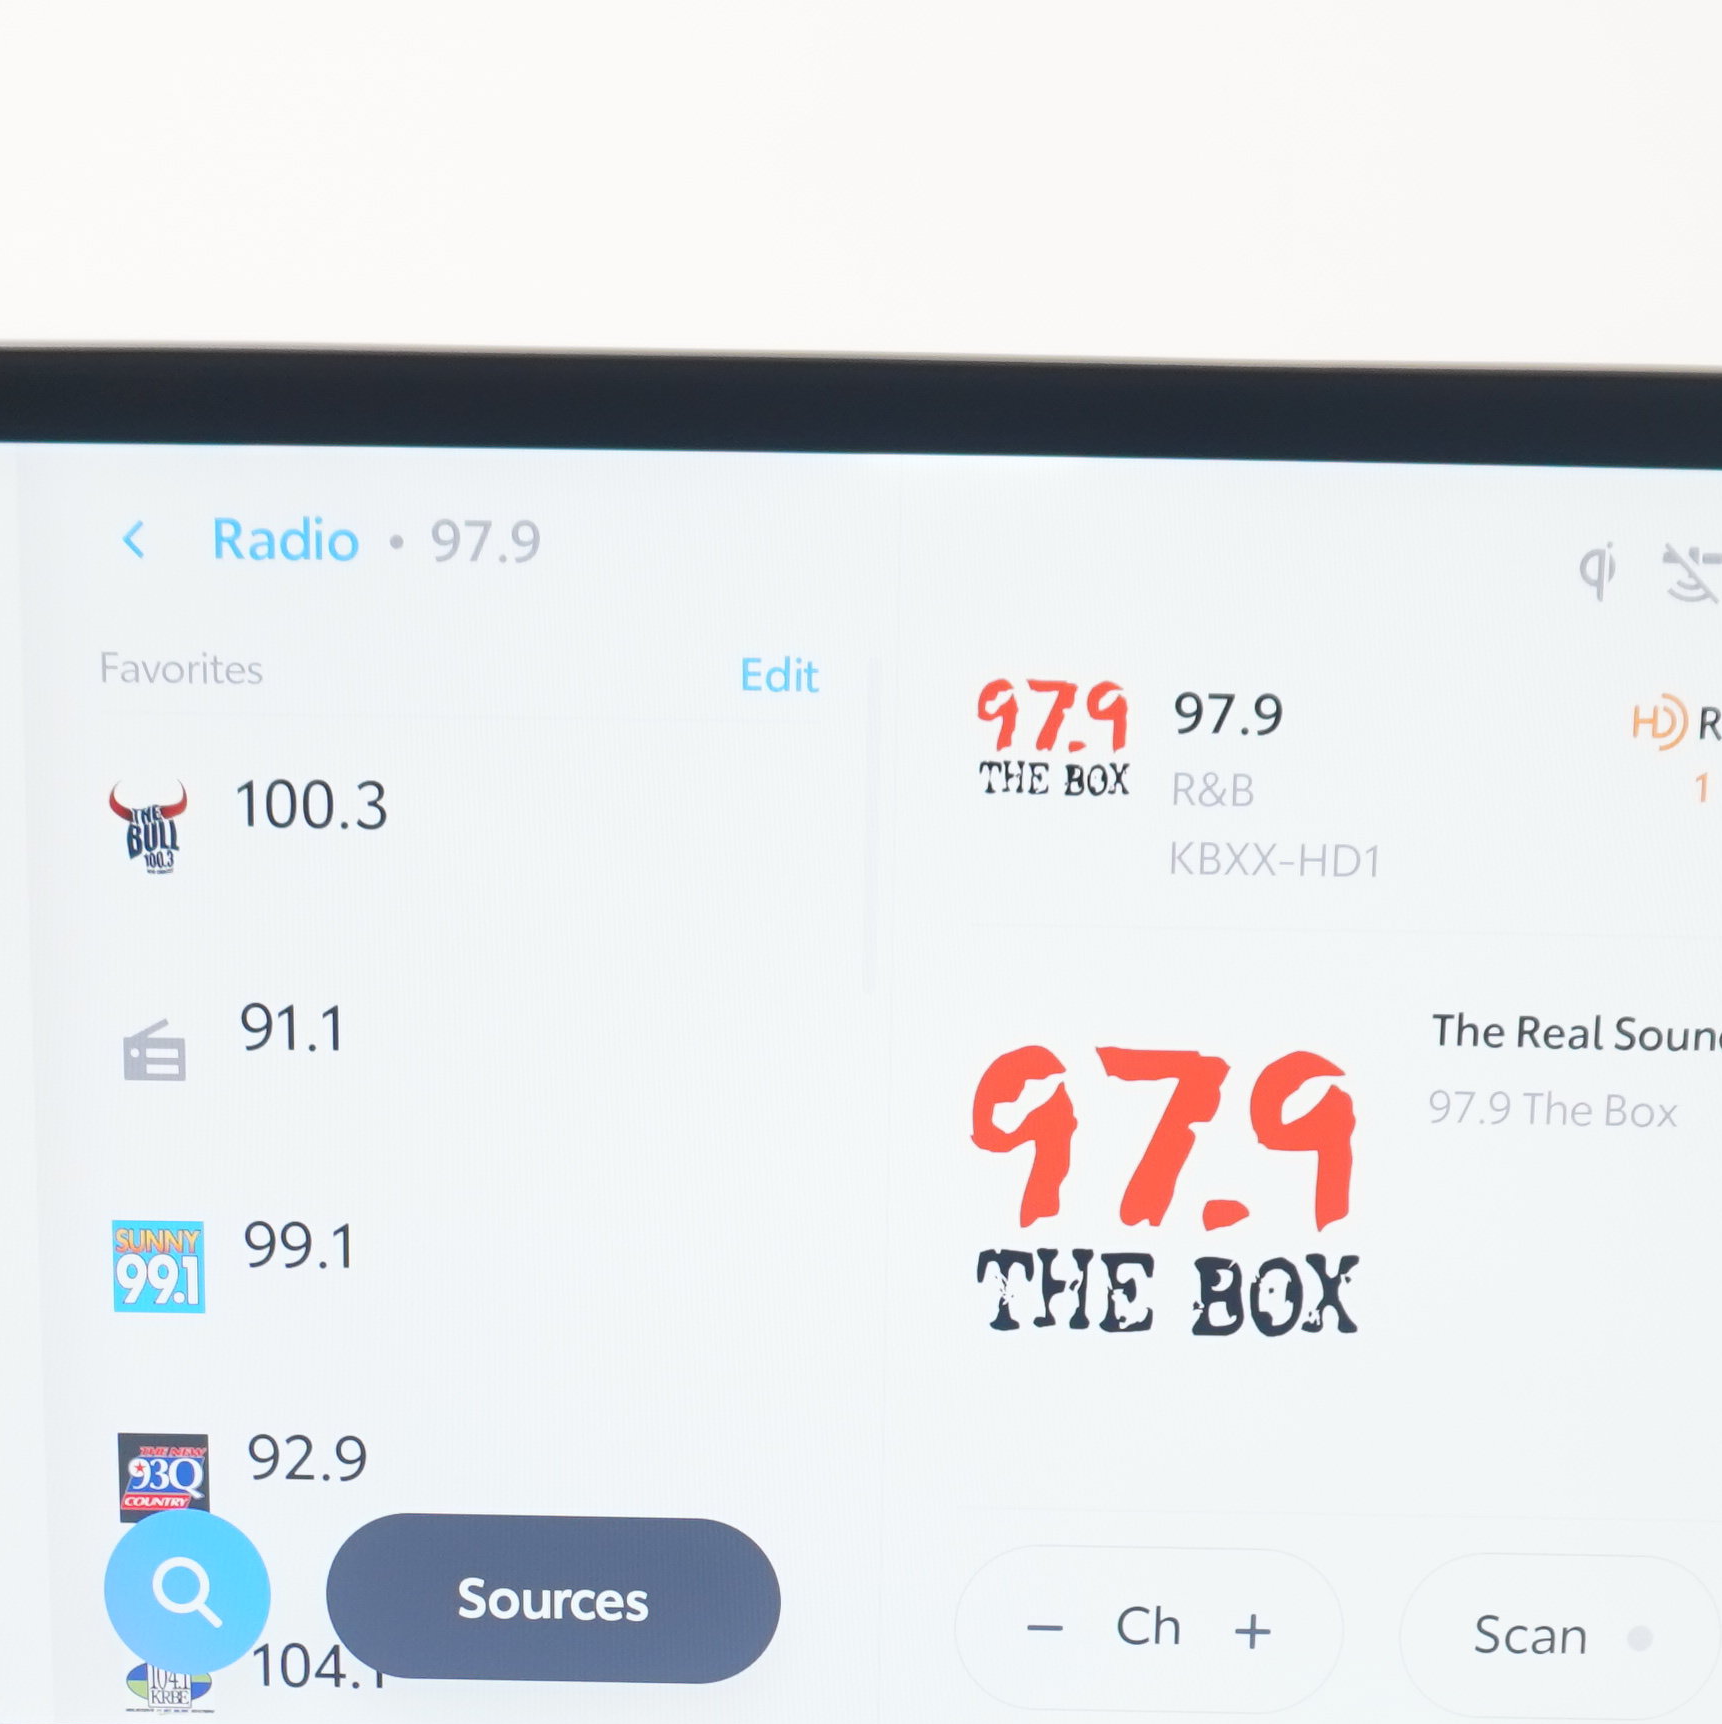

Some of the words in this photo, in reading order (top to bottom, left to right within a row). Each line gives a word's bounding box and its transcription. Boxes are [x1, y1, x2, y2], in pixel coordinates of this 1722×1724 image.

[213, 517, 360, 562] Radio
[430, 518, 542, 565] 97.9
[99, 651, 263, 687] Favorites
[741, 656, 819, 693] Edit
[976, 679, 1129, 751] 97.9
[1173, 692, 1284, 738] 97.9
[978, 760, 1050, 794] THE
[1064, 763, 1130, 797] BOX
[1171, 772, 1254, 807] R&B
[1695, 773, 1708, 802] 1
[237, 779, 388, 831] 100.3
[127, 819, 179, 860] BULL
[144, 850, 174, 868] 100.3
[1169, 840, 1381, 878] KBXX-HD1
[240, 1003, 343, 1052] 91.1
[1433, 1013, 1505, 1048] The
[1516, 1014, 1603, 1051] Real
[1428, 1090, 1511, 1127] 97.9
[1523, 1091, 1592, 1127] The
[1603, 1093, 1677, 1128] Box
[970, 1045, 1355, 1231] 97.9
[115, 1228, 199, 1255] SUNNY
[244, 1221, 353, 1269] 99.1
[116, 1254, 199, 1307] 99.1
[977, 1248, 1154, 1333] THE
[1193, 1255, 1358, 1336] BOX
[248, 1434, 367, 1481] 92.9
[128, 1458, 205, 1499] 93Q
[124, 1496, 189, 1507] COUNTRY
[458, 1577, 649, 1623] Sources
[1117, 1605, 1181, 1645] Ch
[1474, 1616, 1587, 1656] Scan
